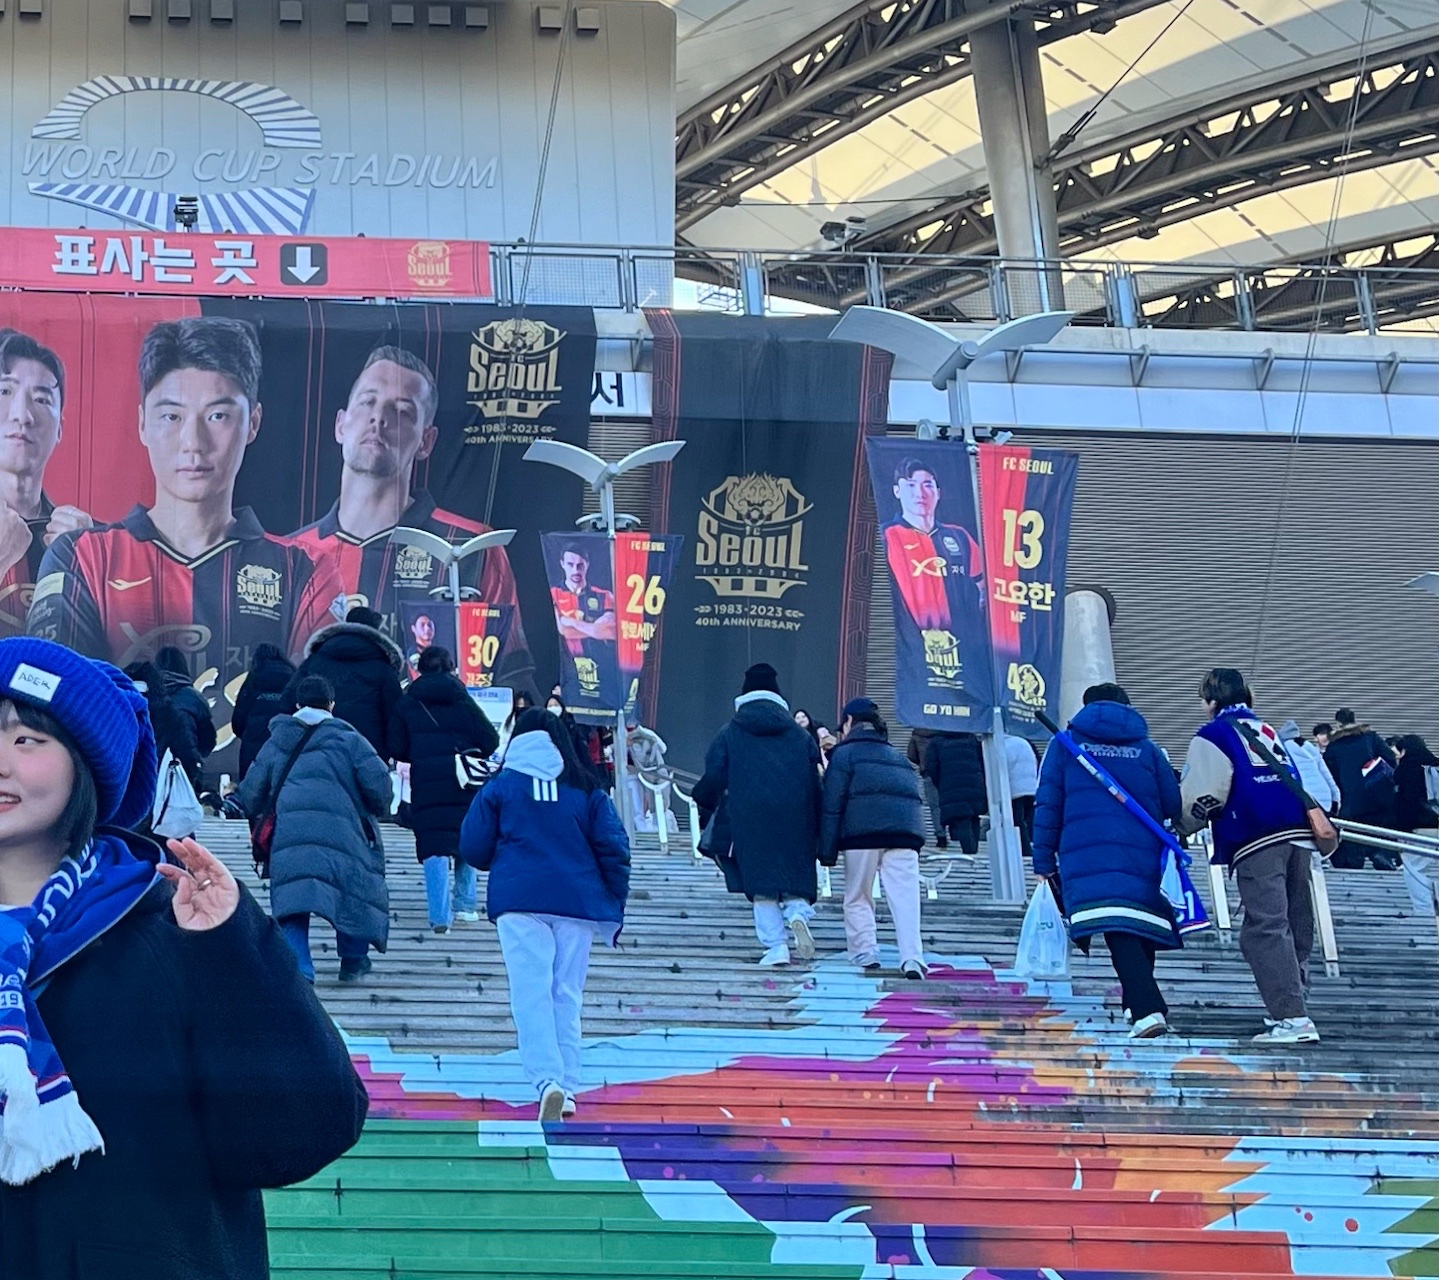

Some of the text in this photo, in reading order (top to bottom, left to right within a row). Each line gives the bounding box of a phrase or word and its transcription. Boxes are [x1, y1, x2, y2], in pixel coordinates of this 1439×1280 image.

[21, 144, 175, 180] WORLD
[193, 148, 282, 183] CUP
[293, 152, 499, 189] STADIUM
[51, 235, 258, 286] 표사는 곳
[591, 373, 624, 407] 서
[1003, 457, 1054, 475] FC SEOUL
[631, 540, 666, 552] FC SEOUL
[1002, 508, 1045, 569] 13
[626, 574, 666, 615] 26
[994, 577, 1056, 612] 고요한
[472, 608, 480, 617] FC
[695, 617, 802, 631] 40th ANNIVERSARY
[1010, 610, 1027, 623] MF
[468, 634, 500, 668] 30
[939, 704, 953, 716] YO
